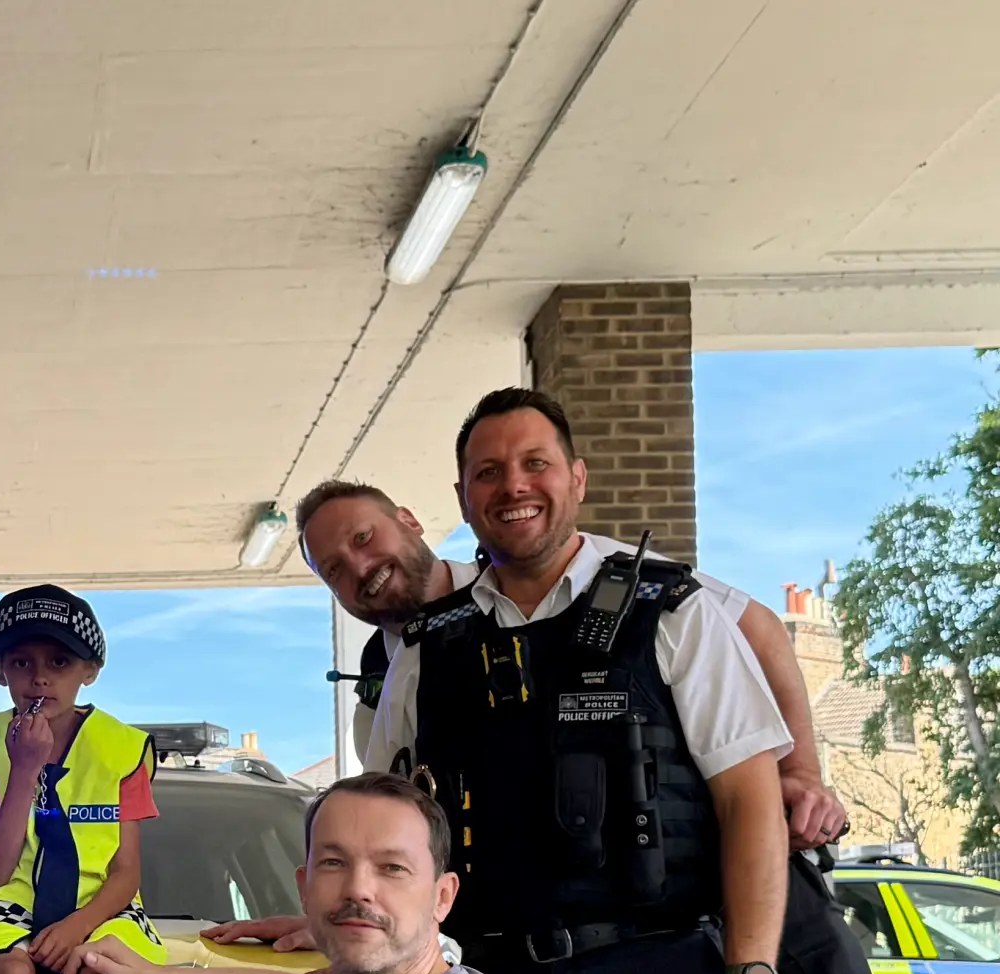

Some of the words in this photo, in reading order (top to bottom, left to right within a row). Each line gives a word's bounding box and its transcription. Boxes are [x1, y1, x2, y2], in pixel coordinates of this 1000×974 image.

[15, 611, 39, 621] POLICE
[40, 612, 69, 624] OFFICER
[558, 712, 590, 721] POLICE
[69, 806, 120, 820] POLICE
